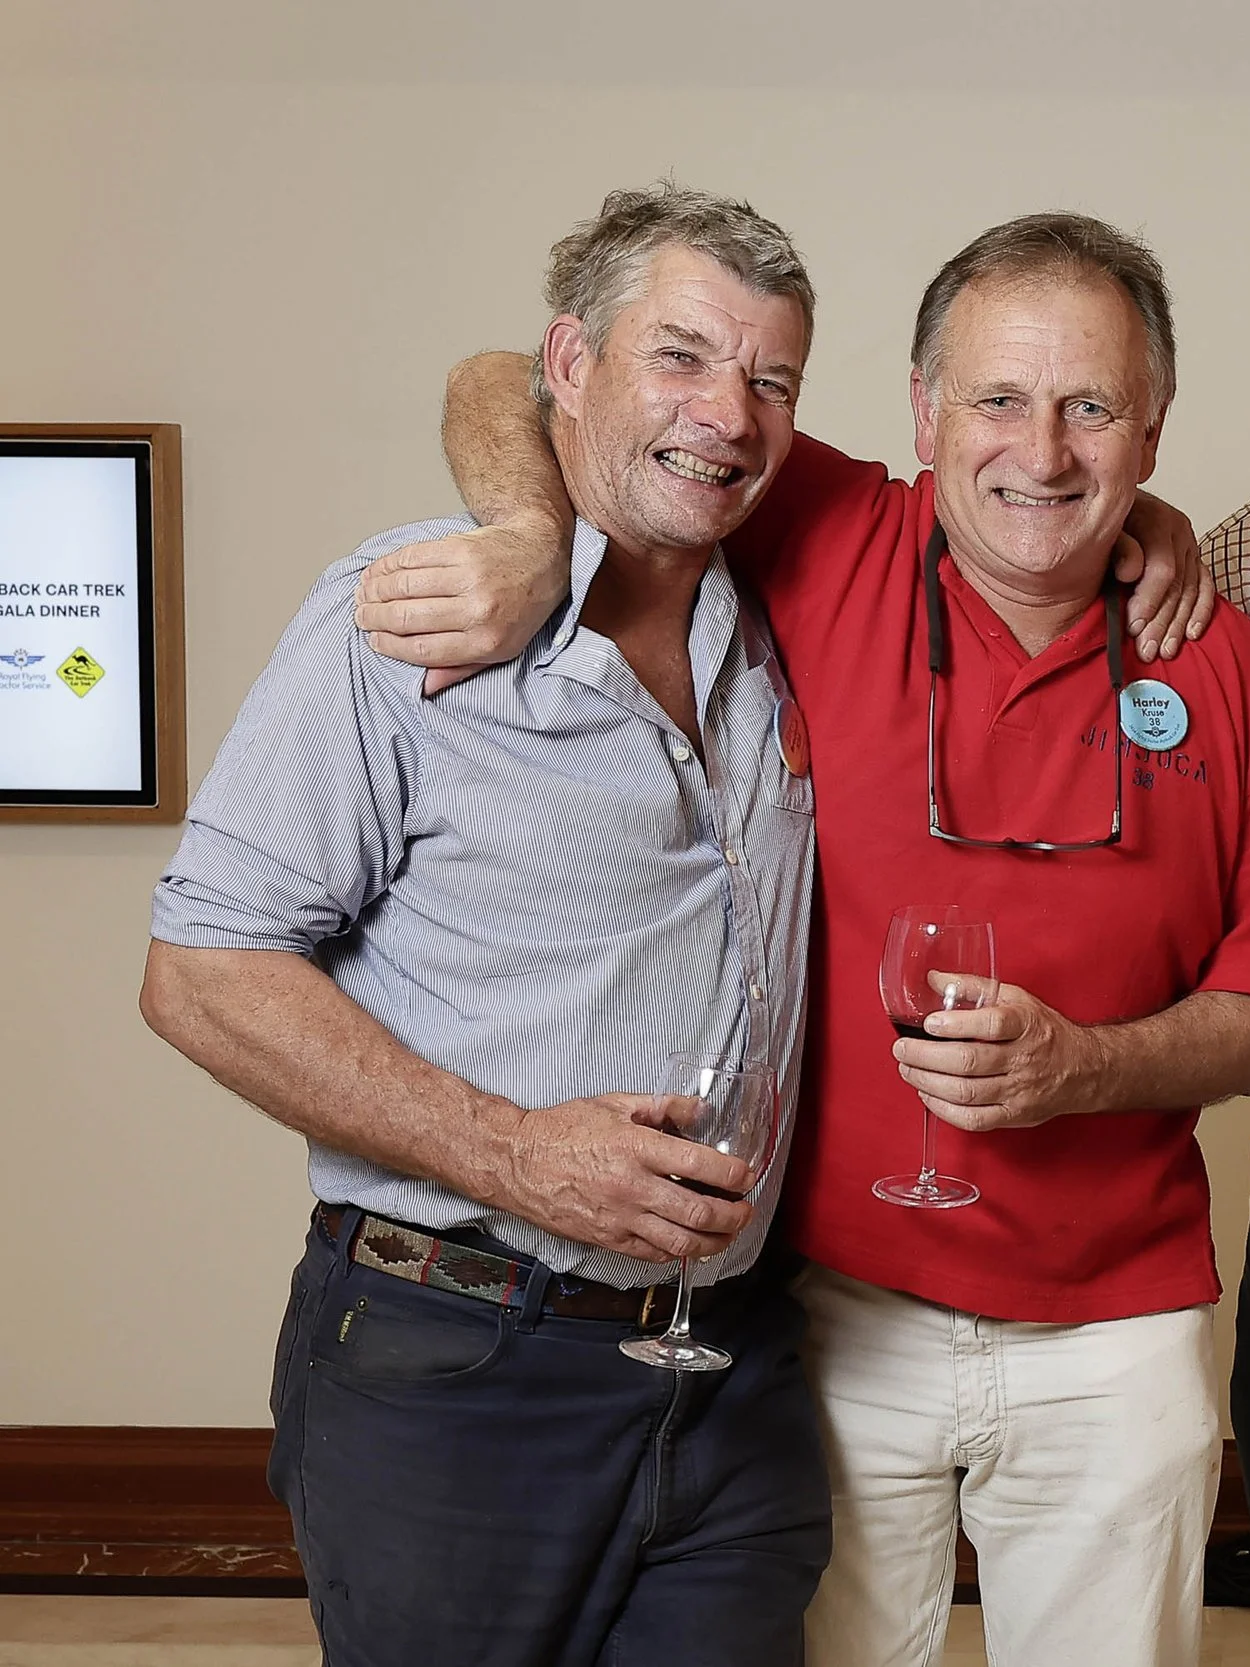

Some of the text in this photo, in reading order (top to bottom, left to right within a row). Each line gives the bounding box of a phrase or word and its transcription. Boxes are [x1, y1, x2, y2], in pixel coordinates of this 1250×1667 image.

[0, 583, 125, 597] BACK CAR TREK
[40, 604, 100, 618] DINNER
[1132, 697, 1170, 710] Harley
[1149, 717, 1161, 727] 38
[1133, 768, 1154, 790] 38
